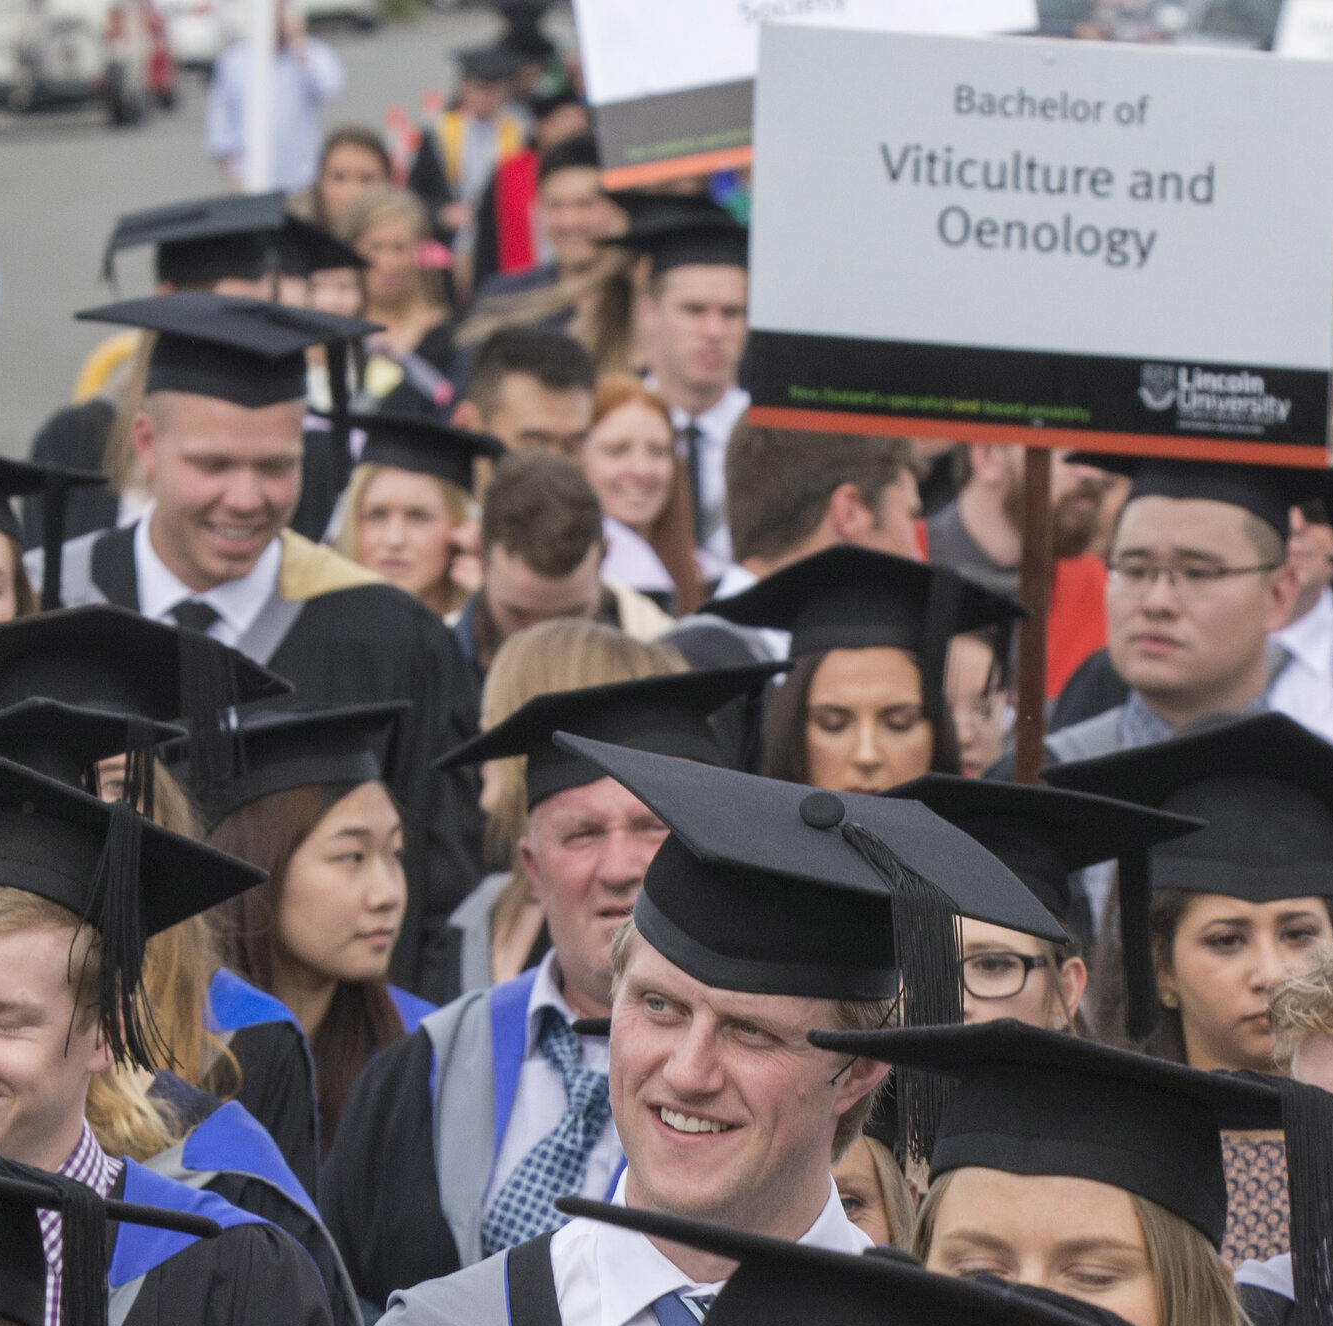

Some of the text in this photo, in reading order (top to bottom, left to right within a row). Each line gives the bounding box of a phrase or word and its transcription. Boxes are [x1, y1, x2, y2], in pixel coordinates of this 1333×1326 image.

[953, 84, 1151, 125] Bachelor of
[880, 142, 1216, 205] Viticulture and
[937, 204, 1158, 269] Oenology
[1178, 366, 1265, 395] Lincoln
[1177, 390, 1292, 425] University
